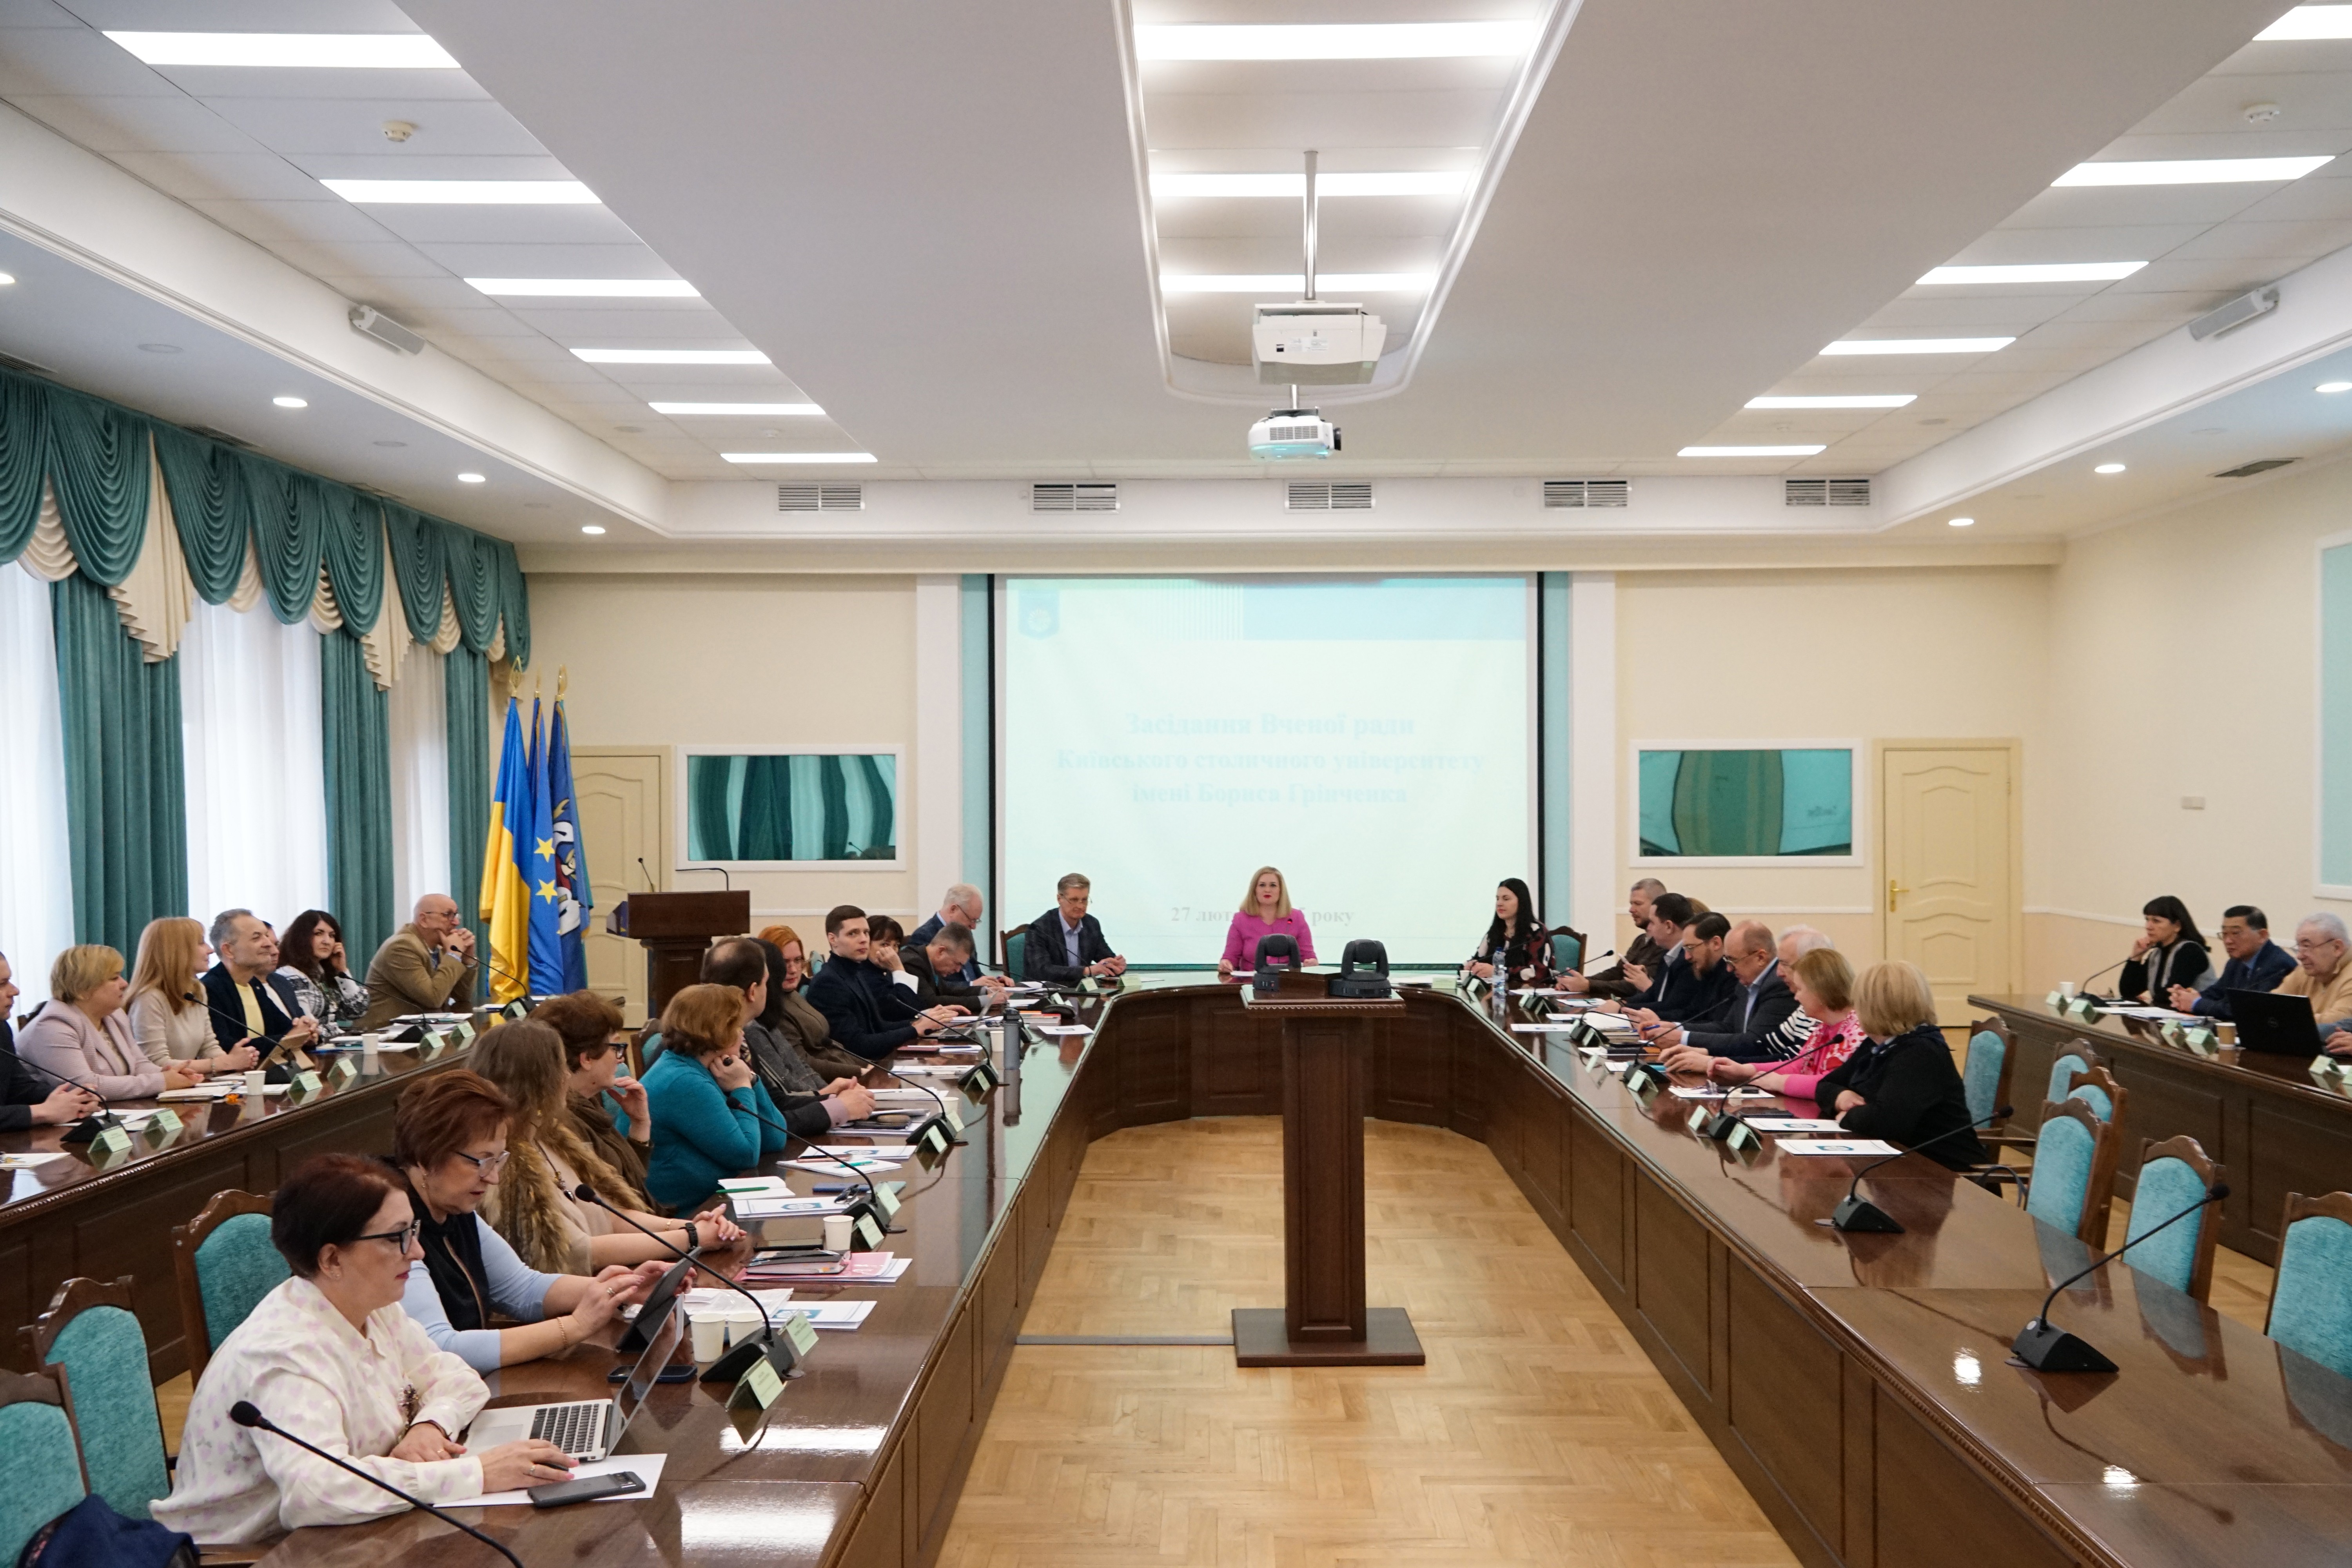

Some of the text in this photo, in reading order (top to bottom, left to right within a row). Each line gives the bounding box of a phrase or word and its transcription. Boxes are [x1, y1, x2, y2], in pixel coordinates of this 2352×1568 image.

[1126, 713, 1415, 740] Засідання Вченої ради
[1057, 749, 1485, 775] Київського столичного університету
[1132, 783, 1408, 808] імені Бориса Грінченка
[1171, 907, 1190, 921] 27
[1312, 912, 1354, 927] року
